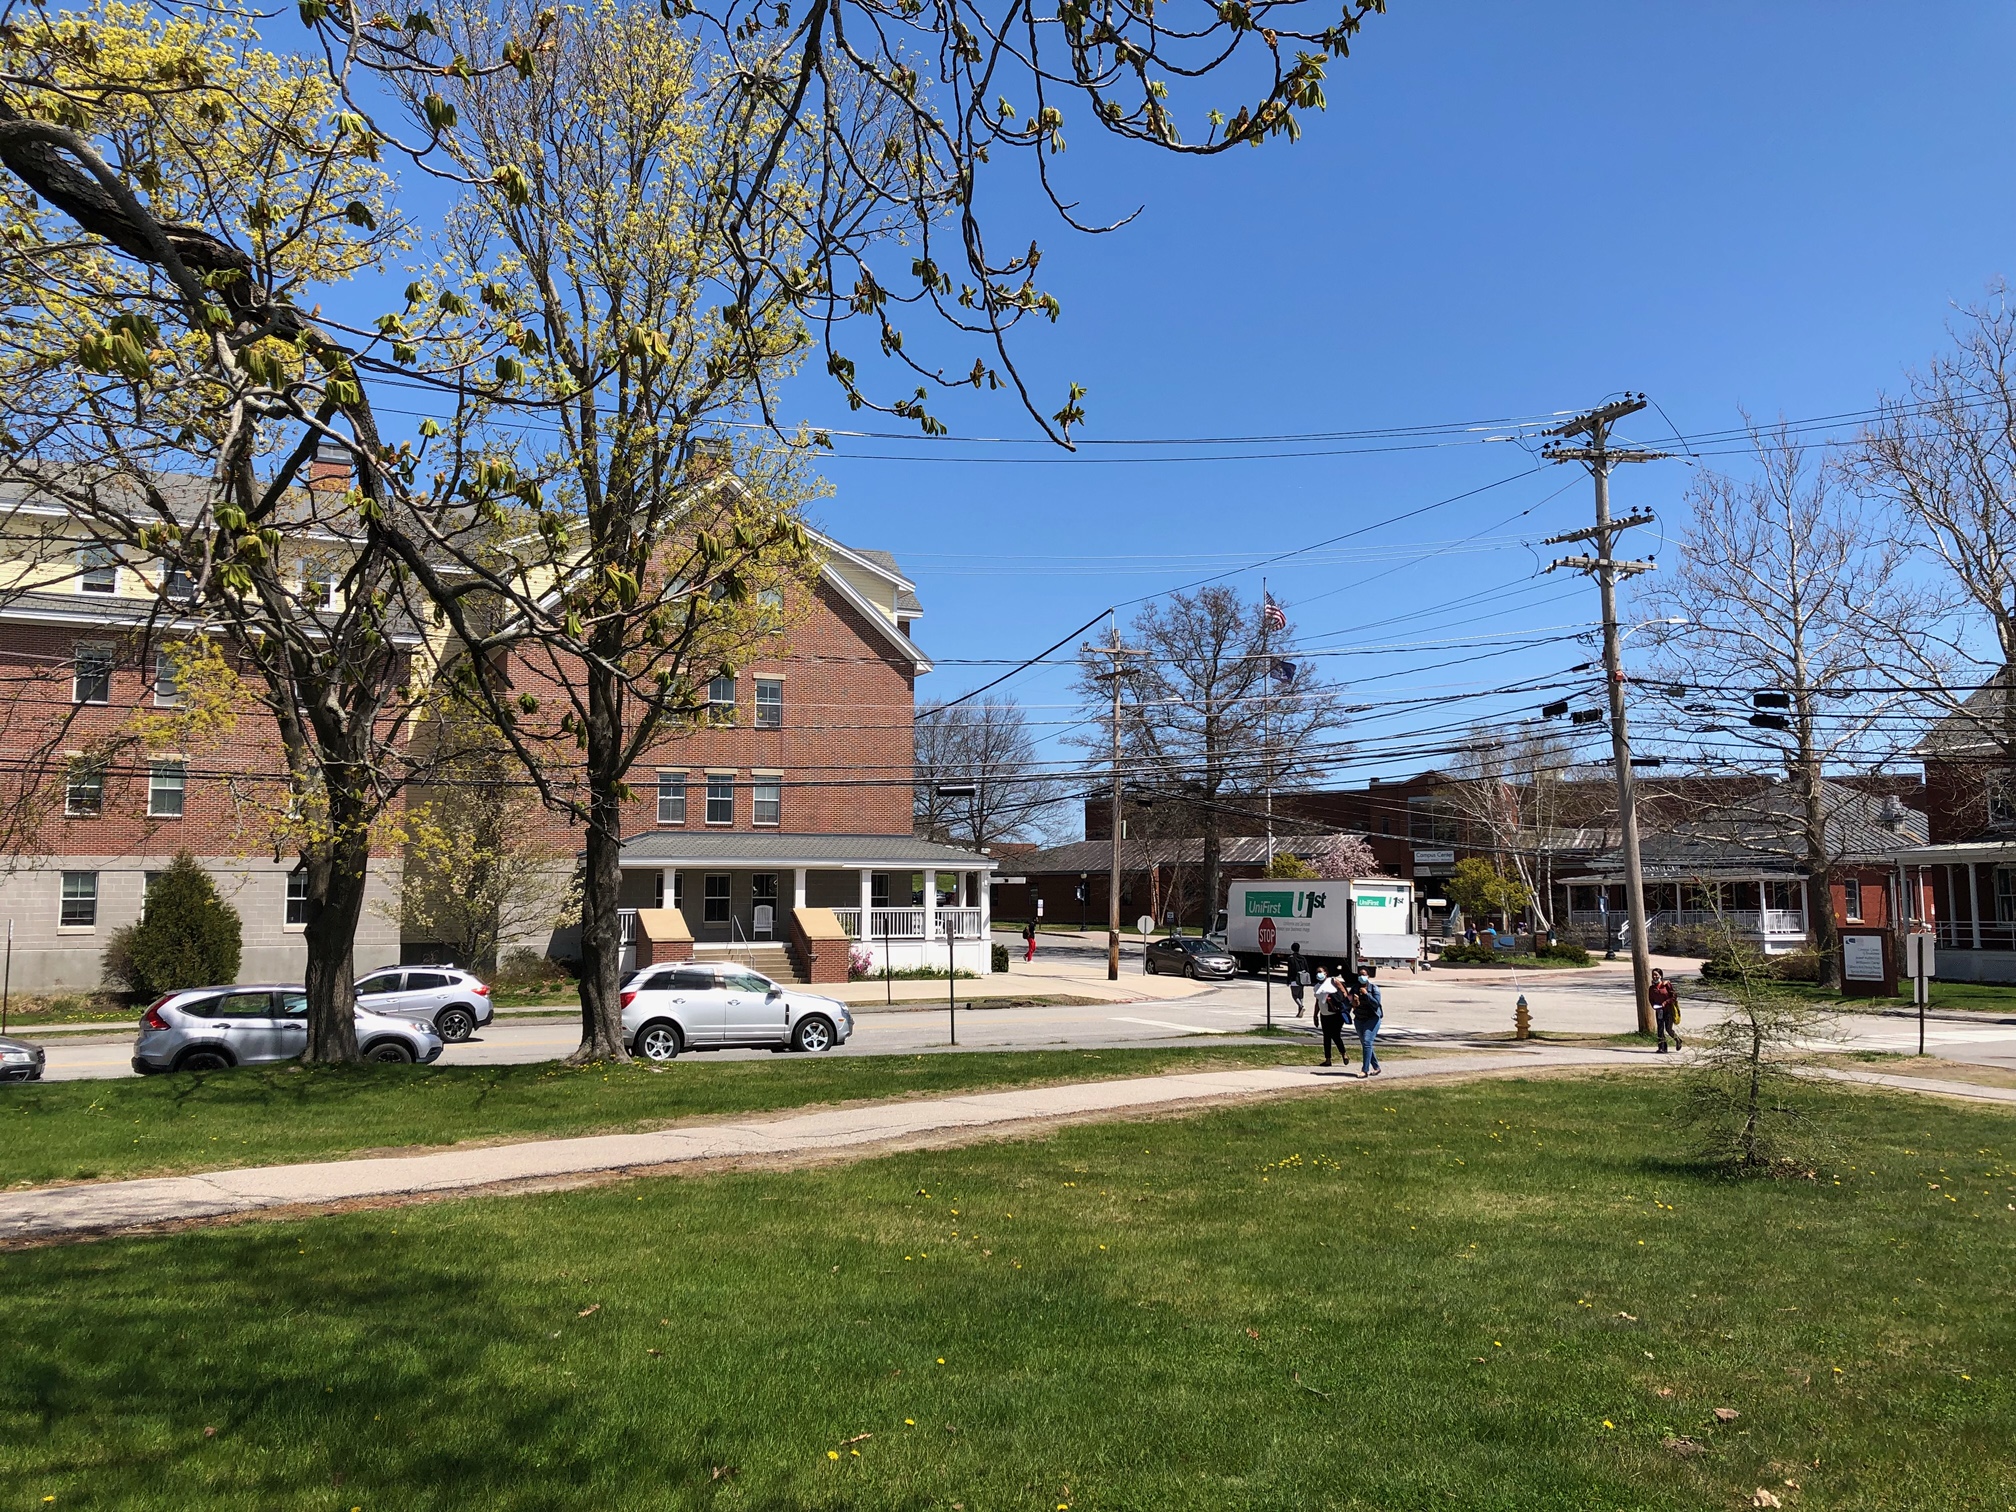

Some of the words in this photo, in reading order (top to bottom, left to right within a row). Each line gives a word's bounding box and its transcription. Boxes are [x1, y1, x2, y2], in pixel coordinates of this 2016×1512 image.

[1248, 900, 1282, 914] UniFirst
[1358, 899, 1380, 907] UniFirst
[1259, 928, 1276, 943] STOP
